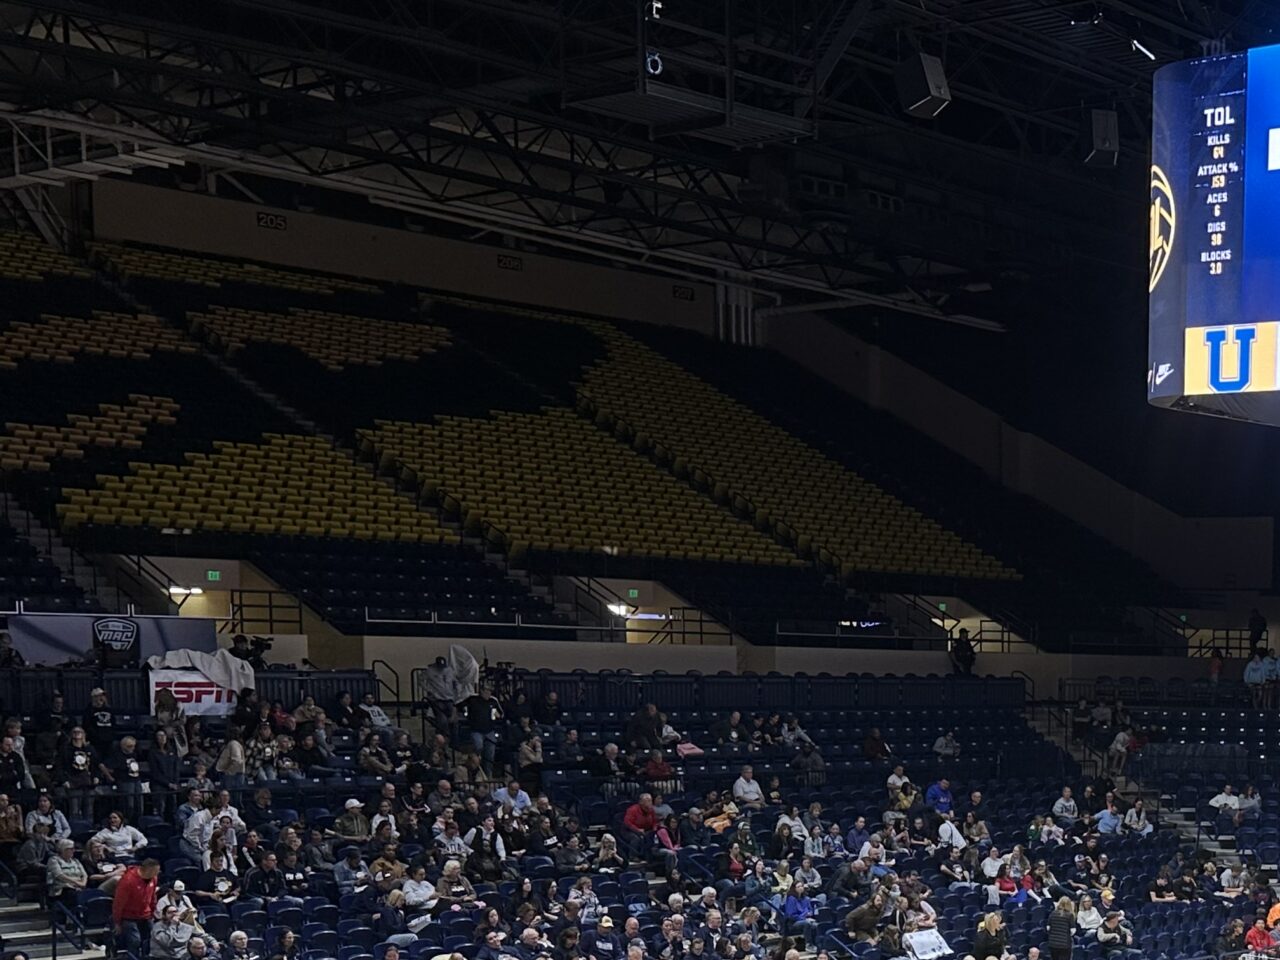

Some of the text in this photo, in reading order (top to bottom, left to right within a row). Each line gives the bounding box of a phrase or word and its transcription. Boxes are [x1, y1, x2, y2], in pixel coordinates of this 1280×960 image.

[1204, 106, 1235, 127] TOL
[1207, 133, 1230, 146] KILLS
[1197, 163, 1228, 176] ATTACK
[1206, 192, 1228, 204] ACES
[1214, 204, 1221, 217] 6
[258, 213, 287, 231] 205
[1207, 221, 1226, 232] DIGS
[1201, 249, 1232, 262] BLOCKS
[1204, 326, 1257, 393] U
[100, 631, 133, 642] MAC
